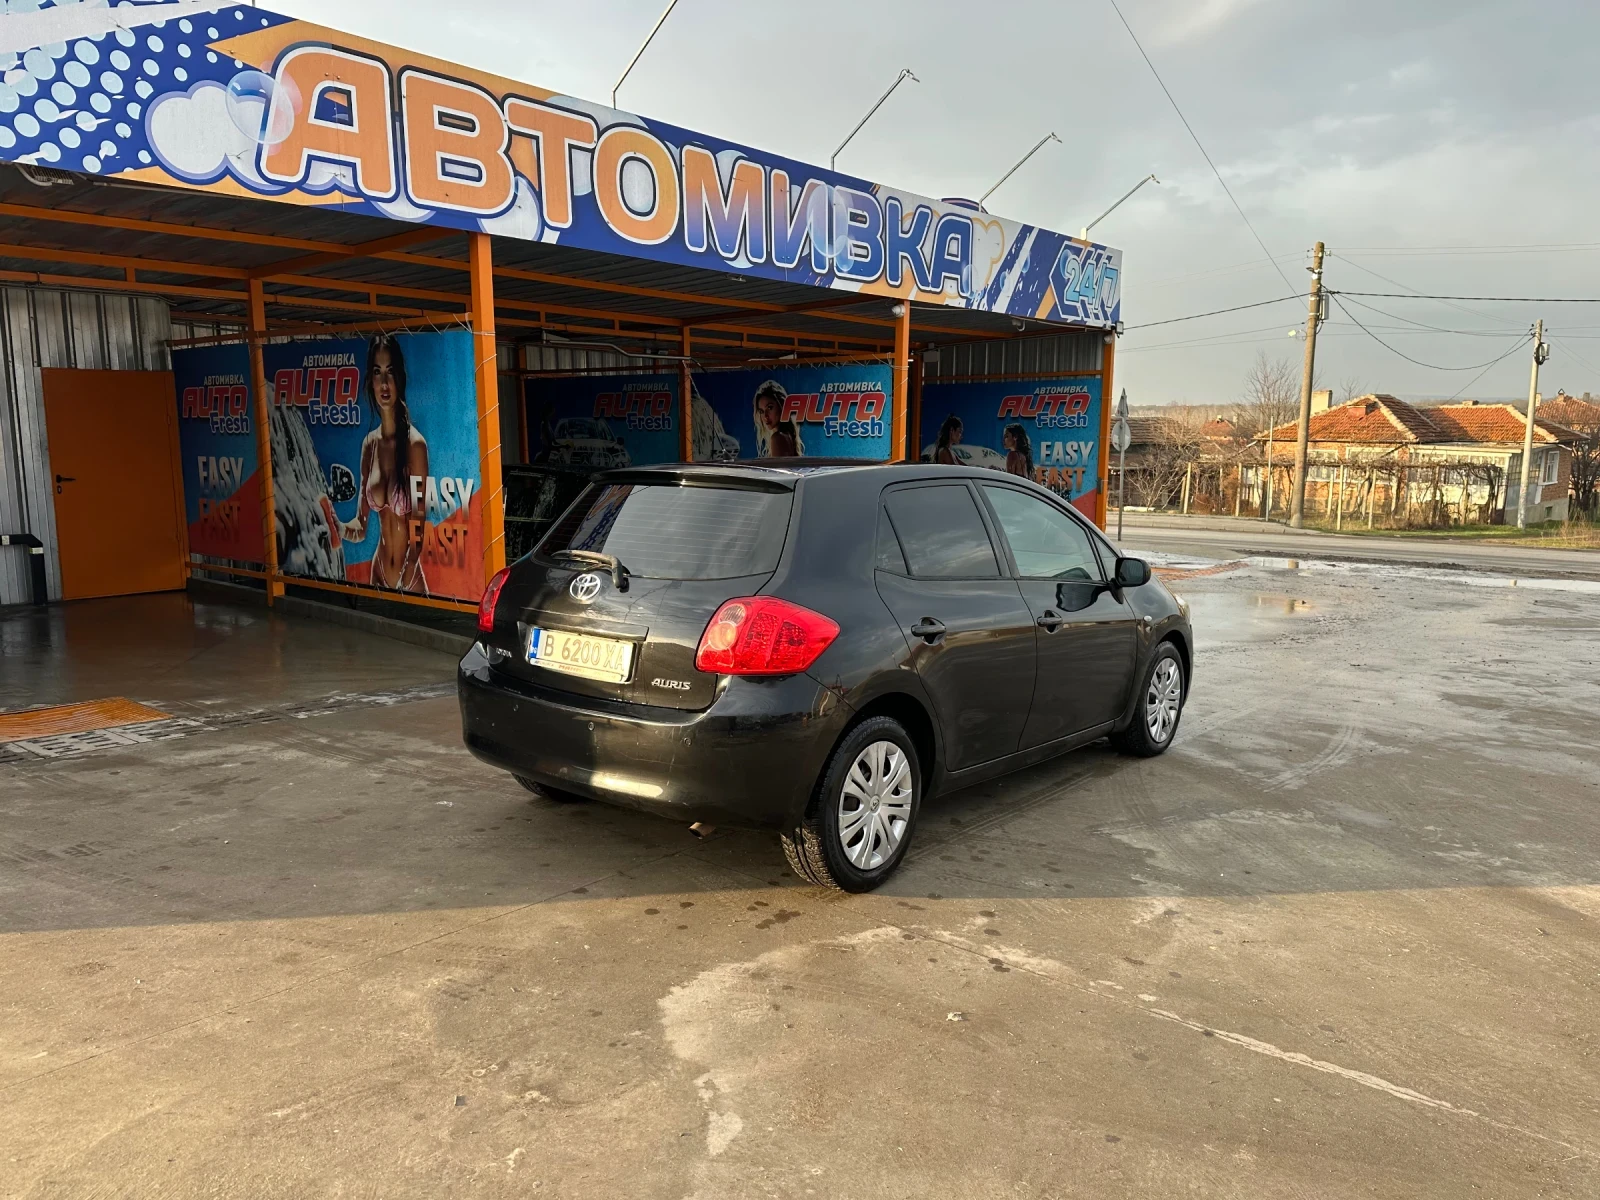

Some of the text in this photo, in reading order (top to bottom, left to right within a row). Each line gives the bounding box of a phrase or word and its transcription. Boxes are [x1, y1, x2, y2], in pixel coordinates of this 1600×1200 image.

[260, 44, 974, 297] АВТОМИВКА
[1065, 257, 1119, 310] 24/7
[303, 353, 355, 367] АВТОМИВКА
[203, 374, 244, 386] АВТОМИВКА
[274, 367, 359, 407] AUTO
[622, 382, 669, 392] АВТОМИВКА
[820, 381, 882, 393] АВТОМИВКА
[1034, 386, 1088, 394] АВТОМИВКА
[182, 385, 248, 418] AUTO
[308, 398, 360, 425] Fresh
[594, 392, 672, 418] AUTO
[780, 393, 886, 423] AUTO
[997, 393, 1091, 418] AUTO
[209, 411, 249, 434] Fresh
[626, 412, 672, 431] Fresh
[823, 416, 883, 438] Fresh
[1035, 412, 1088, 428] Fresh
[1041, 441, 1093, 465] EASY
[197, 455, 244, 493] EASY
[1036, 467, 1085, 491] FAST
[409, 475, 474, 521] EASY
[199, 498, 241, 544] FAST
[408, 519, 468, 568] FAST
[562, 637, 602, 666] 6200
[651, 678, 692, 690] AURIS
